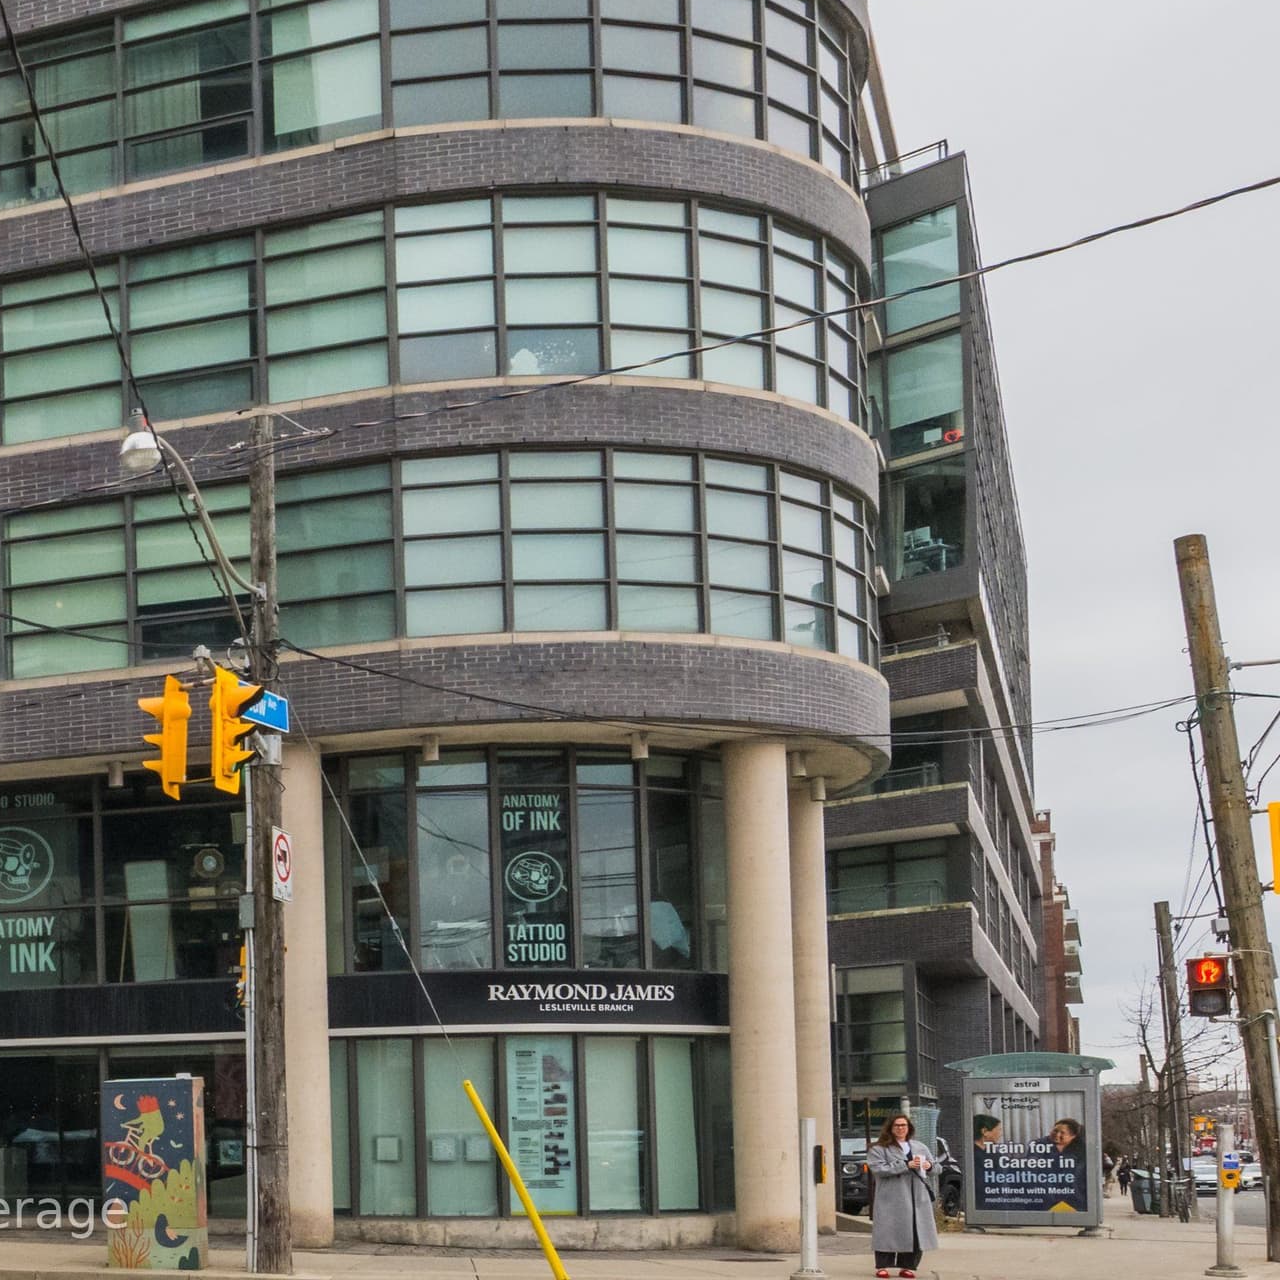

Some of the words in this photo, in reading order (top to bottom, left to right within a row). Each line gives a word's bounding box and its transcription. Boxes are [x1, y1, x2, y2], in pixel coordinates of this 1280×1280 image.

[14, 792, 55, 807] STUDIO
[502, 794, 561, 808] ANATOMY
[502, 811, 525, 831] OF
[530, 810, 561, 831] INK
[506, 923, 566, 941] TATTOO
[10, 941, 57, 973] INK
[507, 943, 567, 962] STUDIO
[487, 984, 608, 1001] RAYMOND
[610, 984, 675, 1002] JAMES
[539, 1003, 596, 1012] LESLIEVILLE
[598, 1003, 634, 1012] BRANCH
[1014, 1080, 1040, 1088] astral
[983, 1141, 1024, 1154] Train
[1028, 1141, 1053, 1154] for
[983, 1158, 993, 1168] a
[998, 1156, 1054, 1169] Career
[1059, 1156, 1075, 1168] in
[984, 1171, 1075, 1183] Healthcare
[985, 1187, 1000, 1195] Get
[1001, 1186, 1024, 1195] Hired
[1027, 1186, 1046, 1195] with
[1048, 1186, 1075, 1195] Medix
